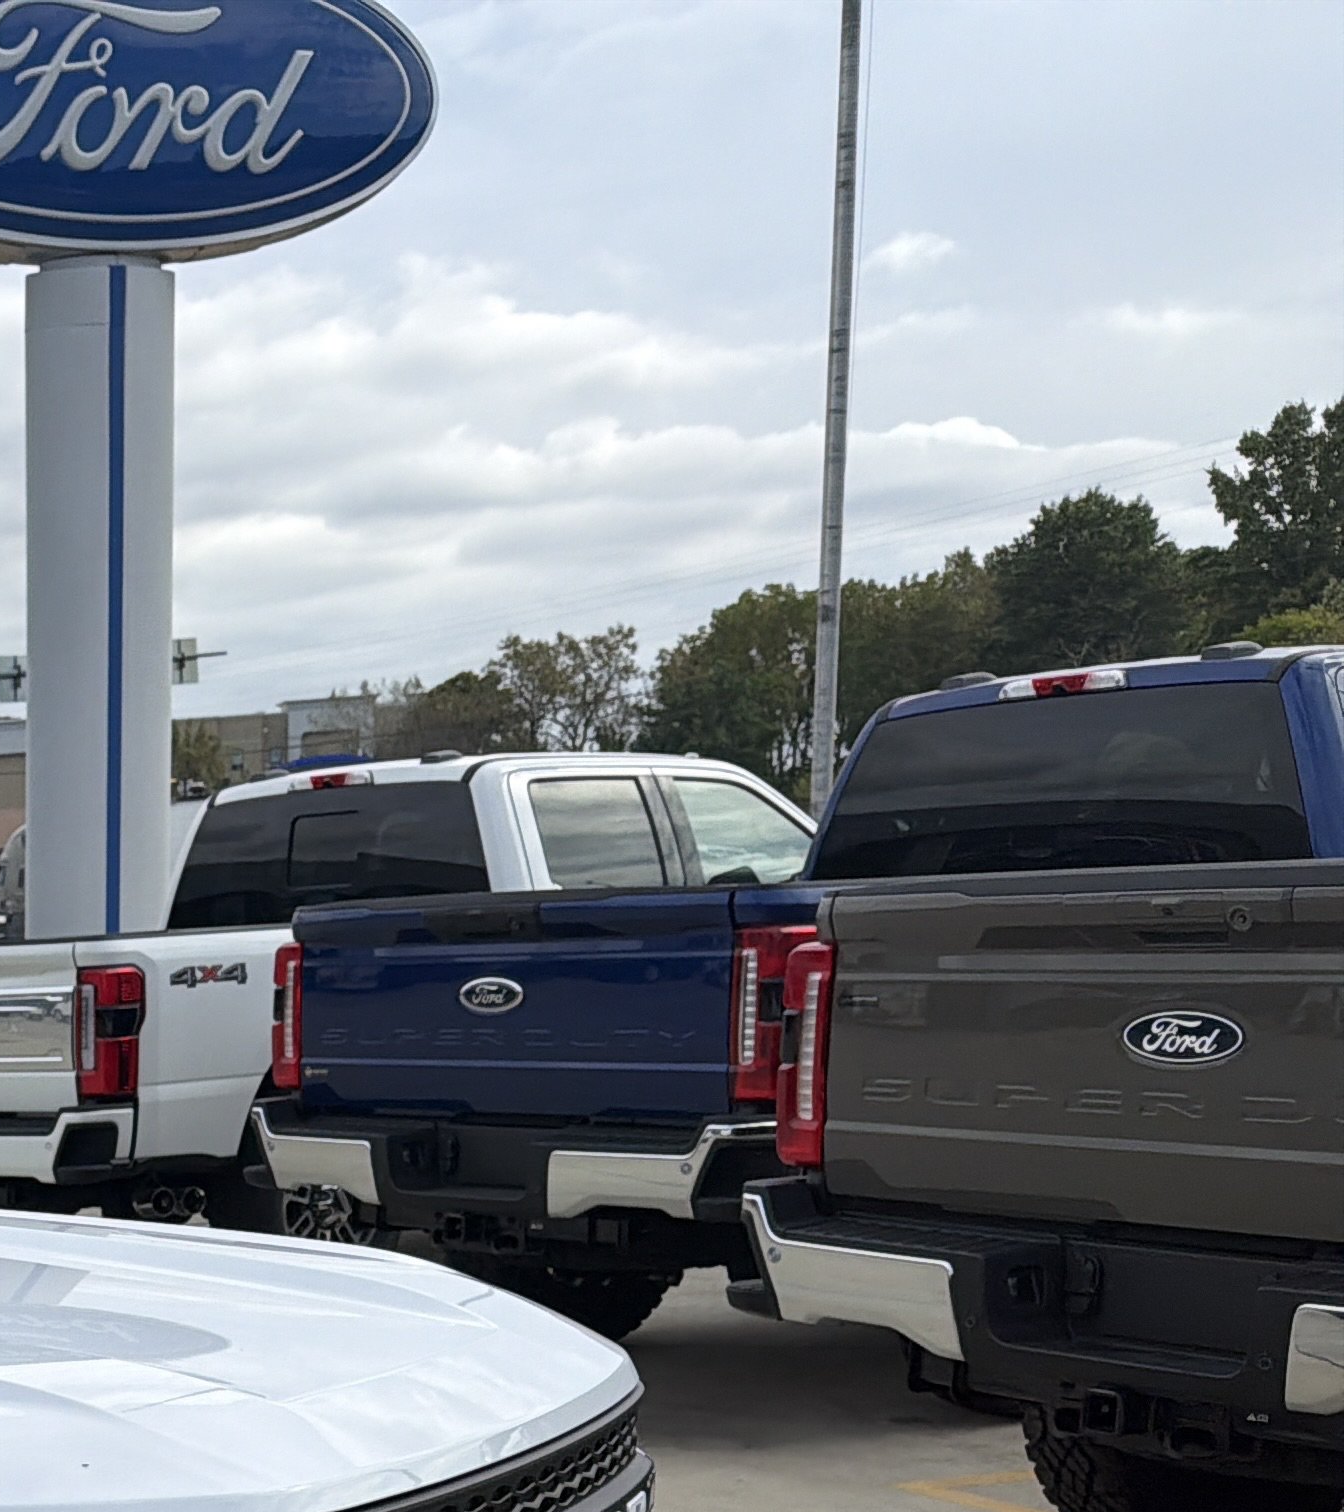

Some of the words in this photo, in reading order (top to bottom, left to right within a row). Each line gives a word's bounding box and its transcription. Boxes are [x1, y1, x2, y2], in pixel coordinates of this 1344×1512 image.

[472, 984, 507, 1007] Ford
[1142, 1017, 1222, 1055] Ford
[861, 1078, 1205, 1120] SUPER
